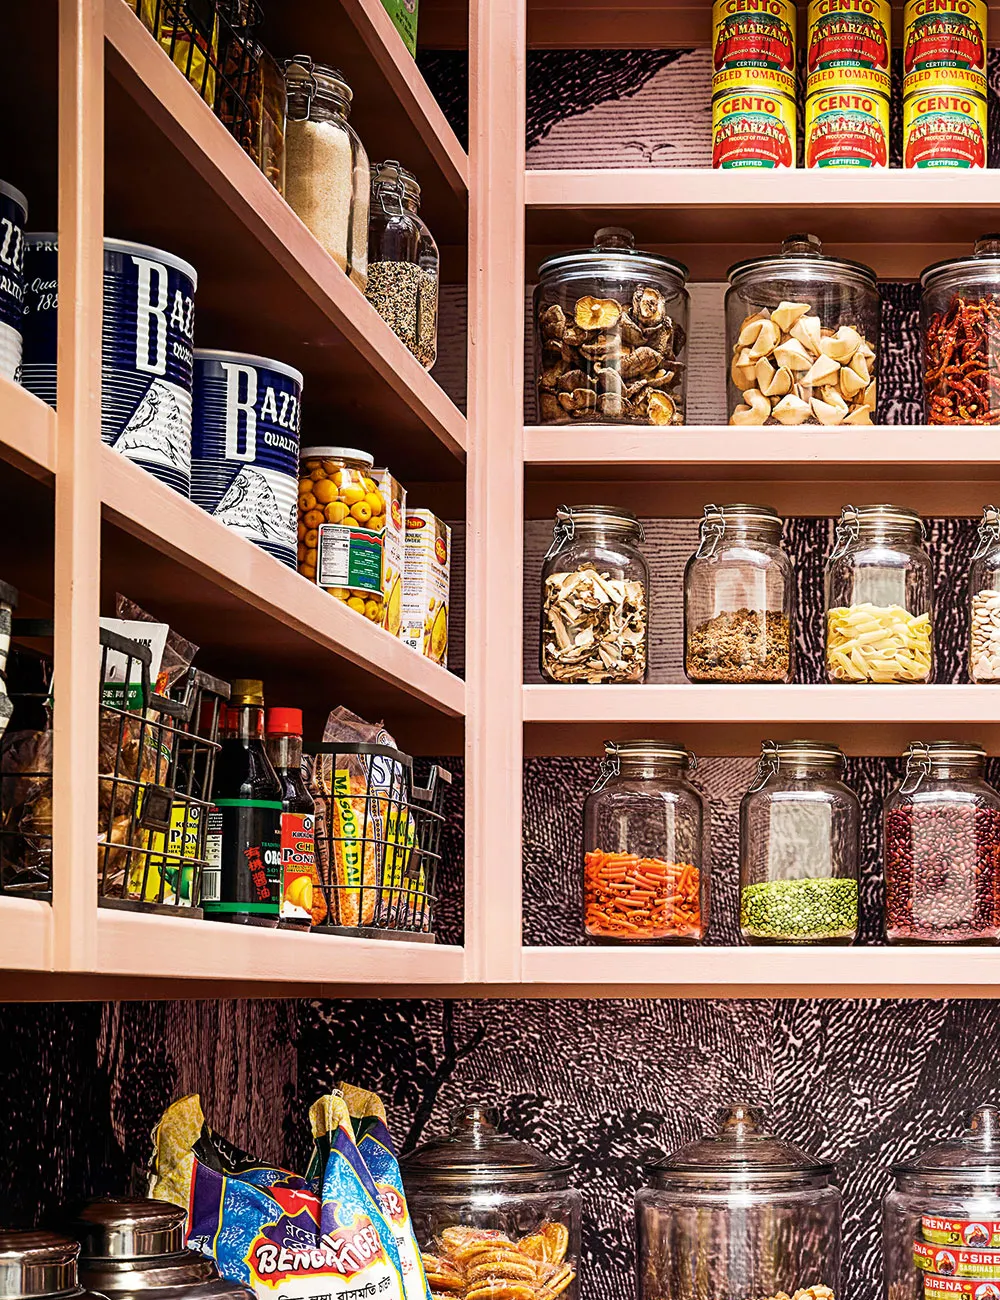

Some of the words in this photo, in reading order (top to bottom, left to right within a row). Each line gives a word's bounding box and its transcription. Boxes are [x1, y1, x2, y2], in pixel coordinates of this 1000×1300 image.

[726, 0, 781, 14] CENTO
[819, 0, 873, 14] CENTO
[915, 0, 970, 15] CENTO
[719, 26, 736, 44] SAN
[739, 23, 789, 46] MARZANO
[812, 28, 829, 46] SAN
[831, 23, 882, 45] MARZANO
[909, 28, 925, 47] SAN
[928, 24, 978, 45] MARZANO
[713, 69, 742, 86] PEELED
[745, 69, 795, 88] TOMATOES
[808, 71, 834, 87] PEELED
[839, 69, 888, 86] TOMATOES
[904, 71, 931, 88] PEELED
[934, 70, 984, 87] TOMATOES
[722, 97, 776, 114] CENTO
[819, 95, 872, 112] CENTO
[917, 97, 971, 113] CENTO
[716, 126, 731, 143] SAN
[733, 121, 786, 144] MARZANO
[811, 125, 828, 143] SAN
[831, 121, 881, 143] MARZANO
[910, 126, 926, 144] SAN
[930, 122, 980, 144] MARZANO
[220, 361, 299, 462] BAZZ
[406, 518, 423, 528] han
[335, 776, 358, 849] MASOOR
[345, 851, 361, 888] DAL
[960, 1264, 993, 1273] SARDINAS
[925, 1279, 962, 1291] SIRENA
